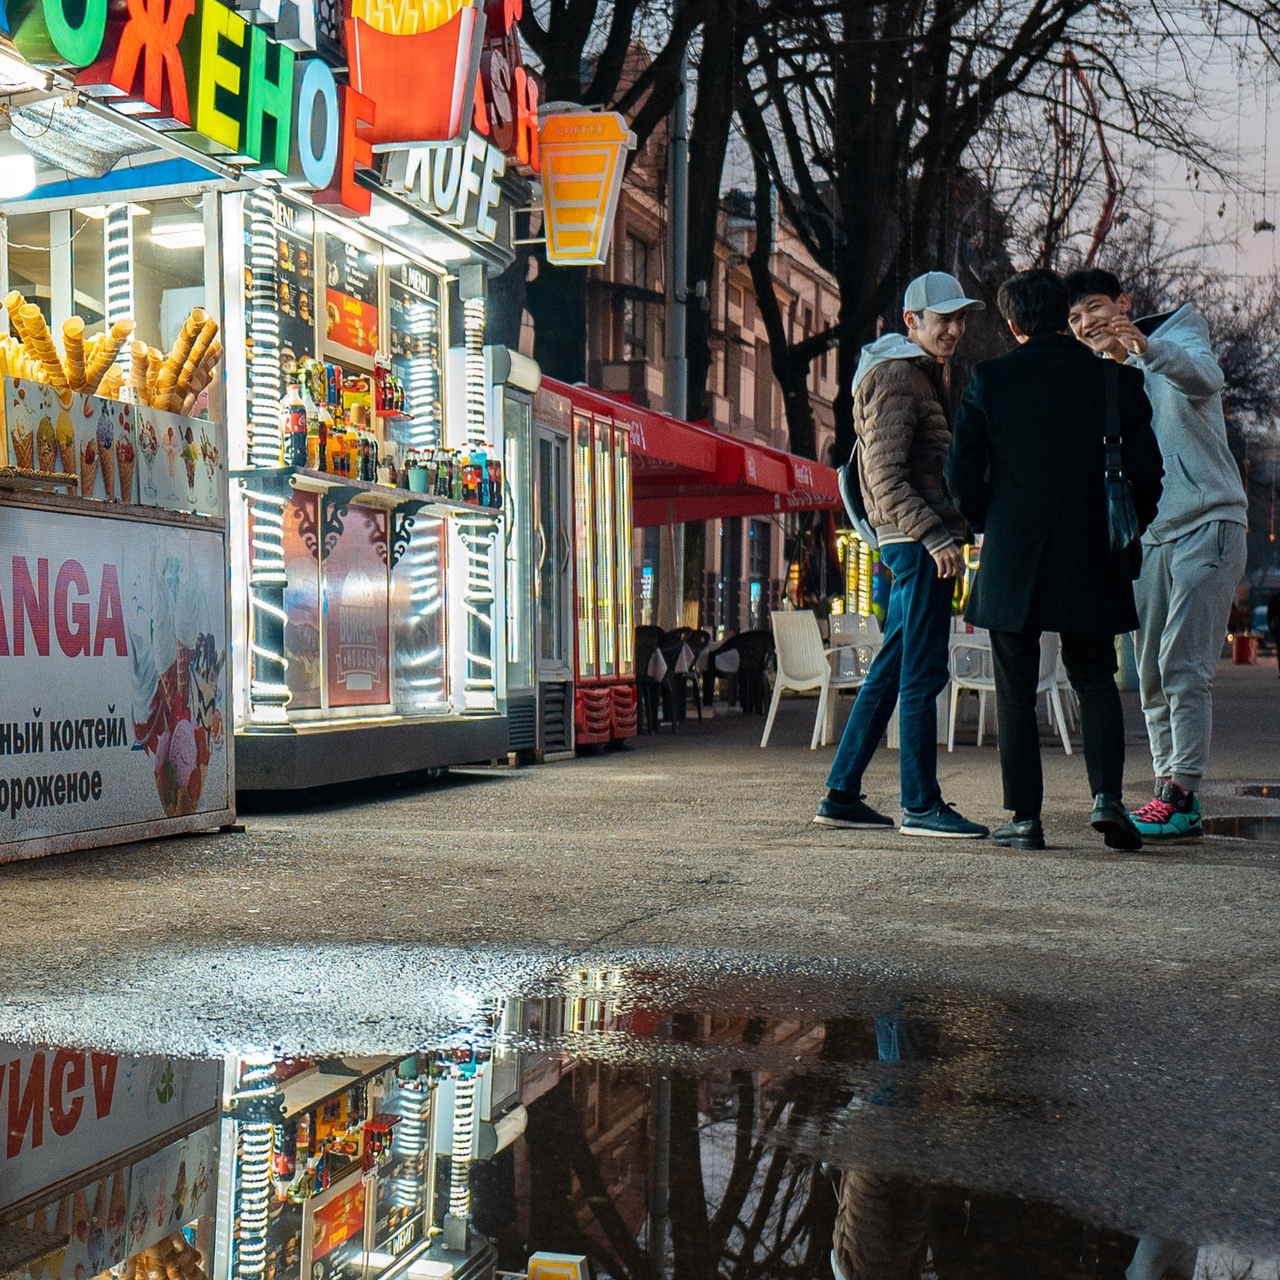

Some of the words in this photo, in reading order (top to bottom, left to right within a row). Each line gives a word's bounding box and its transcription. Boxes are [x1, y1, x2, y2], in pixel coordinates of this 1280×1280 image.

[407, 267, 430, 296] MENU
[339, 606, 378, 643] BURGER
[346, 648, 371, 668] HOUSE
[49, 704, 129, 752] коктейл
